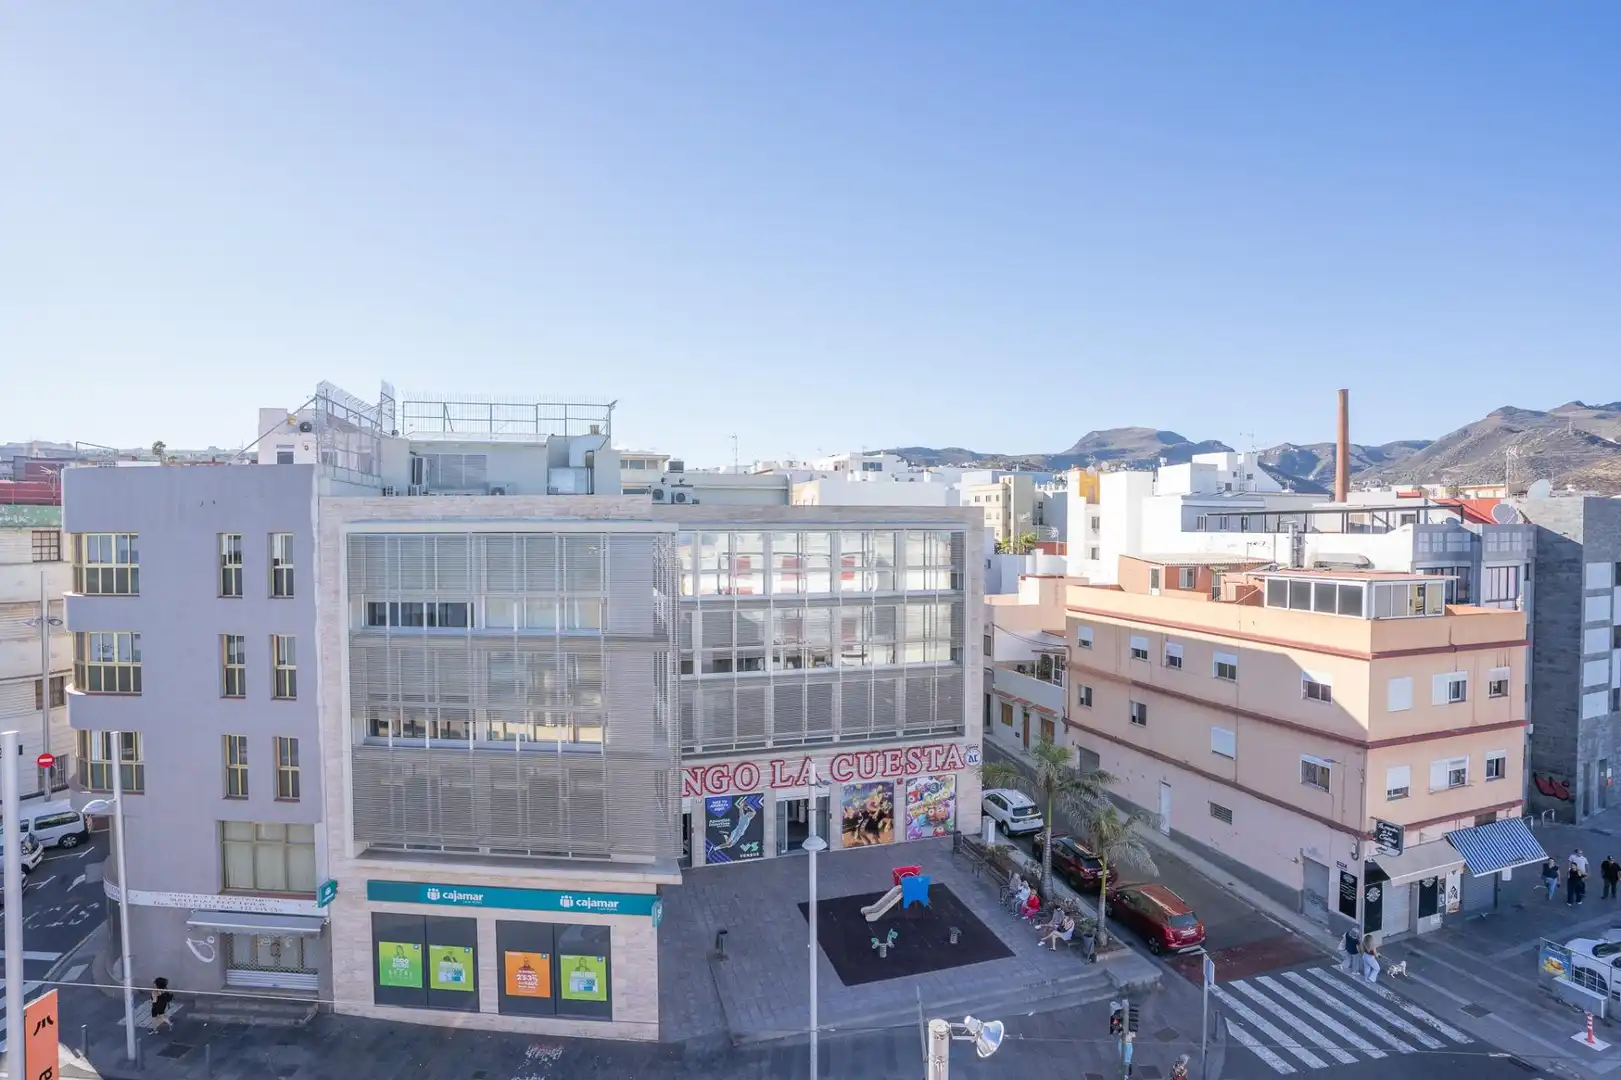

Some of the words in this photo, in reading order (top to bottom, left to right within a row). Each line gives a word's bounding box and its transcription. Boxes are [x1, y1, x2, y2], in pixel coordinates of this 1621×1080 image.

[681, 762, 760, 796] NGO
[770, 756, 822, 788] LA
[831, 743, 965, 782] CUESTA
[442, 890, 484, 903] cajamar
[576, 897, 620, 909] cajamar
